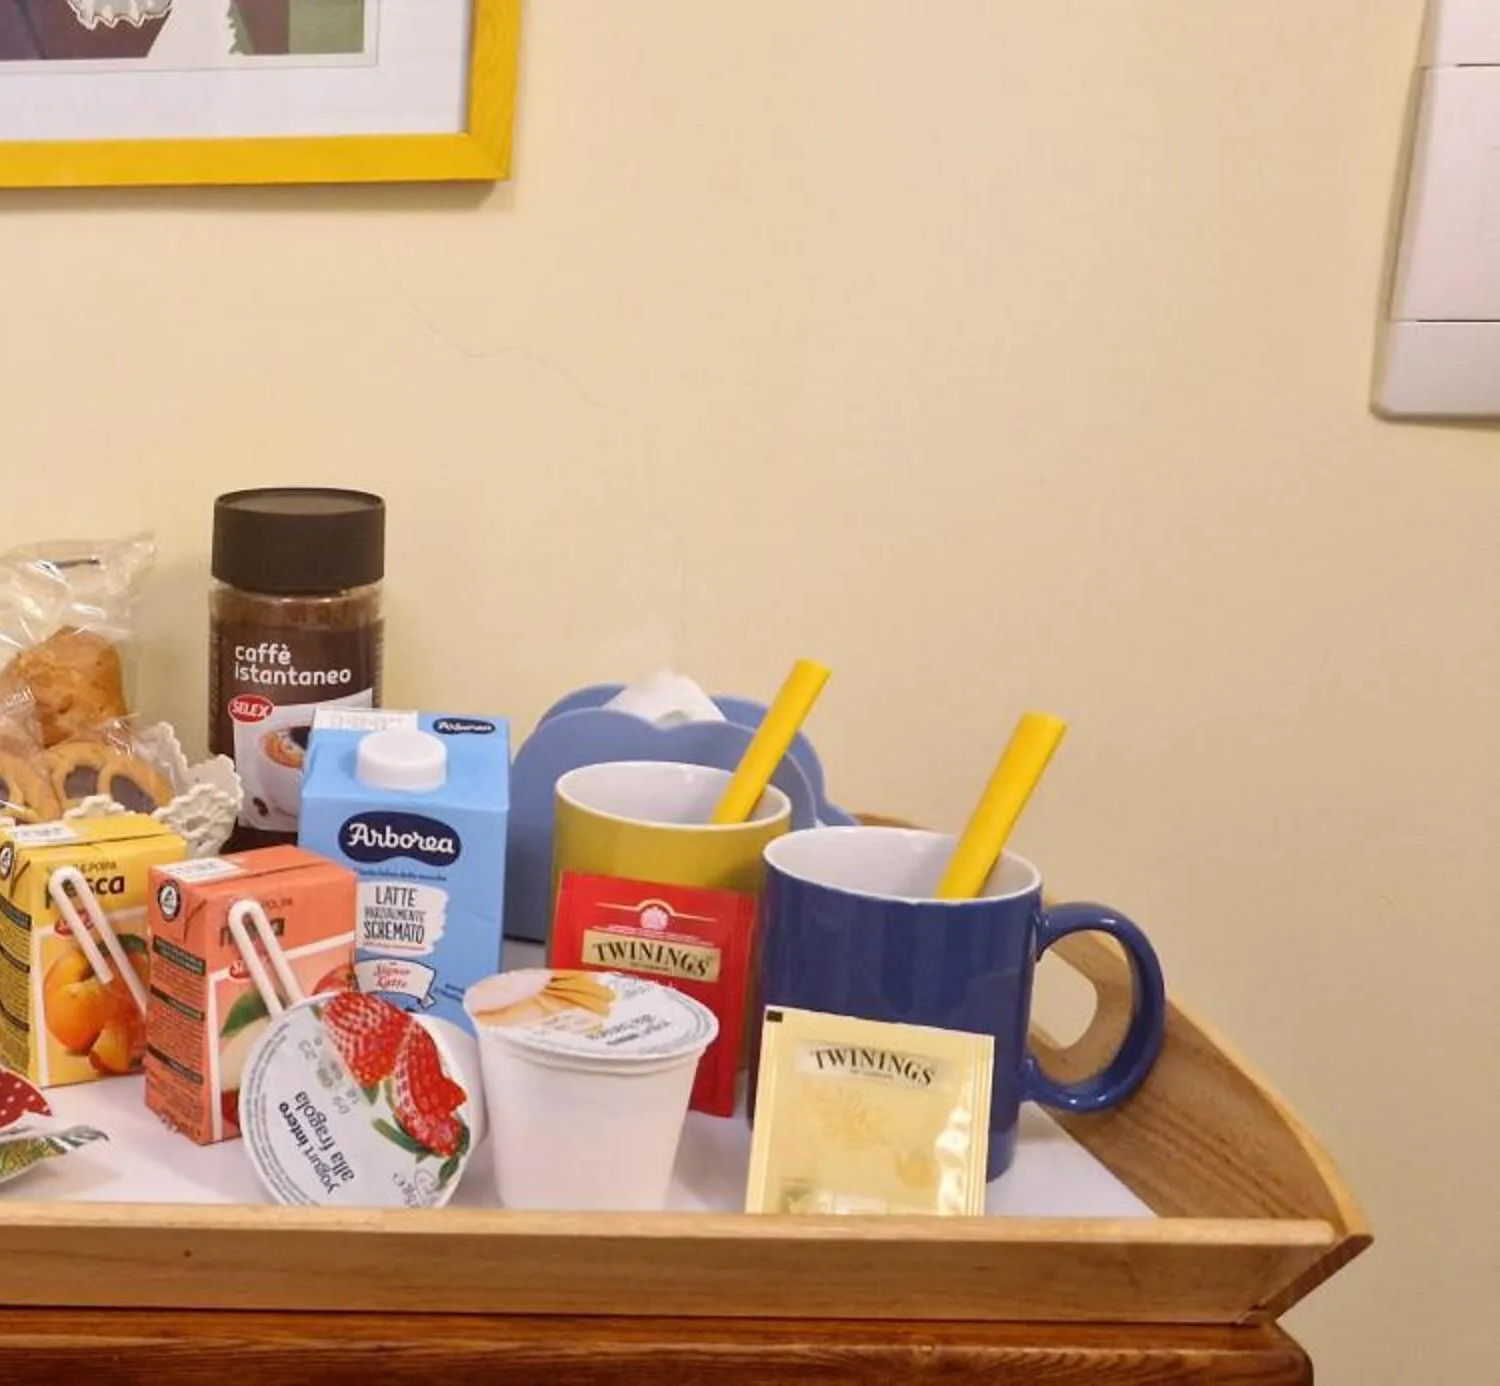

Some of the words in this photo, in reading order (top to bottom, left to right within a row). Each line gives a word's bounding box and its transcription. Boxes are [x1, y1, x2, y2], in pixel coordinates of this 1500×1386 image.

[234, 643, 291, 665] caffè
[234, 665, 352, 686] istantaneo
[231, 701, 269, 718] SELEX
[347, 823, 455, 854] Arborea
[375, 886, 418, 906] LATTE
[363, 921, 426, 945] SCREMATO
[592, 940, 716, 977] TWININGS
[809, 1048, 936, 1086] TWININGS
[278, 1101, 309, 1147] intero
[295, 1090, 336, 1151] fragola
[303, 1145, 340, 1194] yogurt
[331, 1151, 356, 1182] alla
